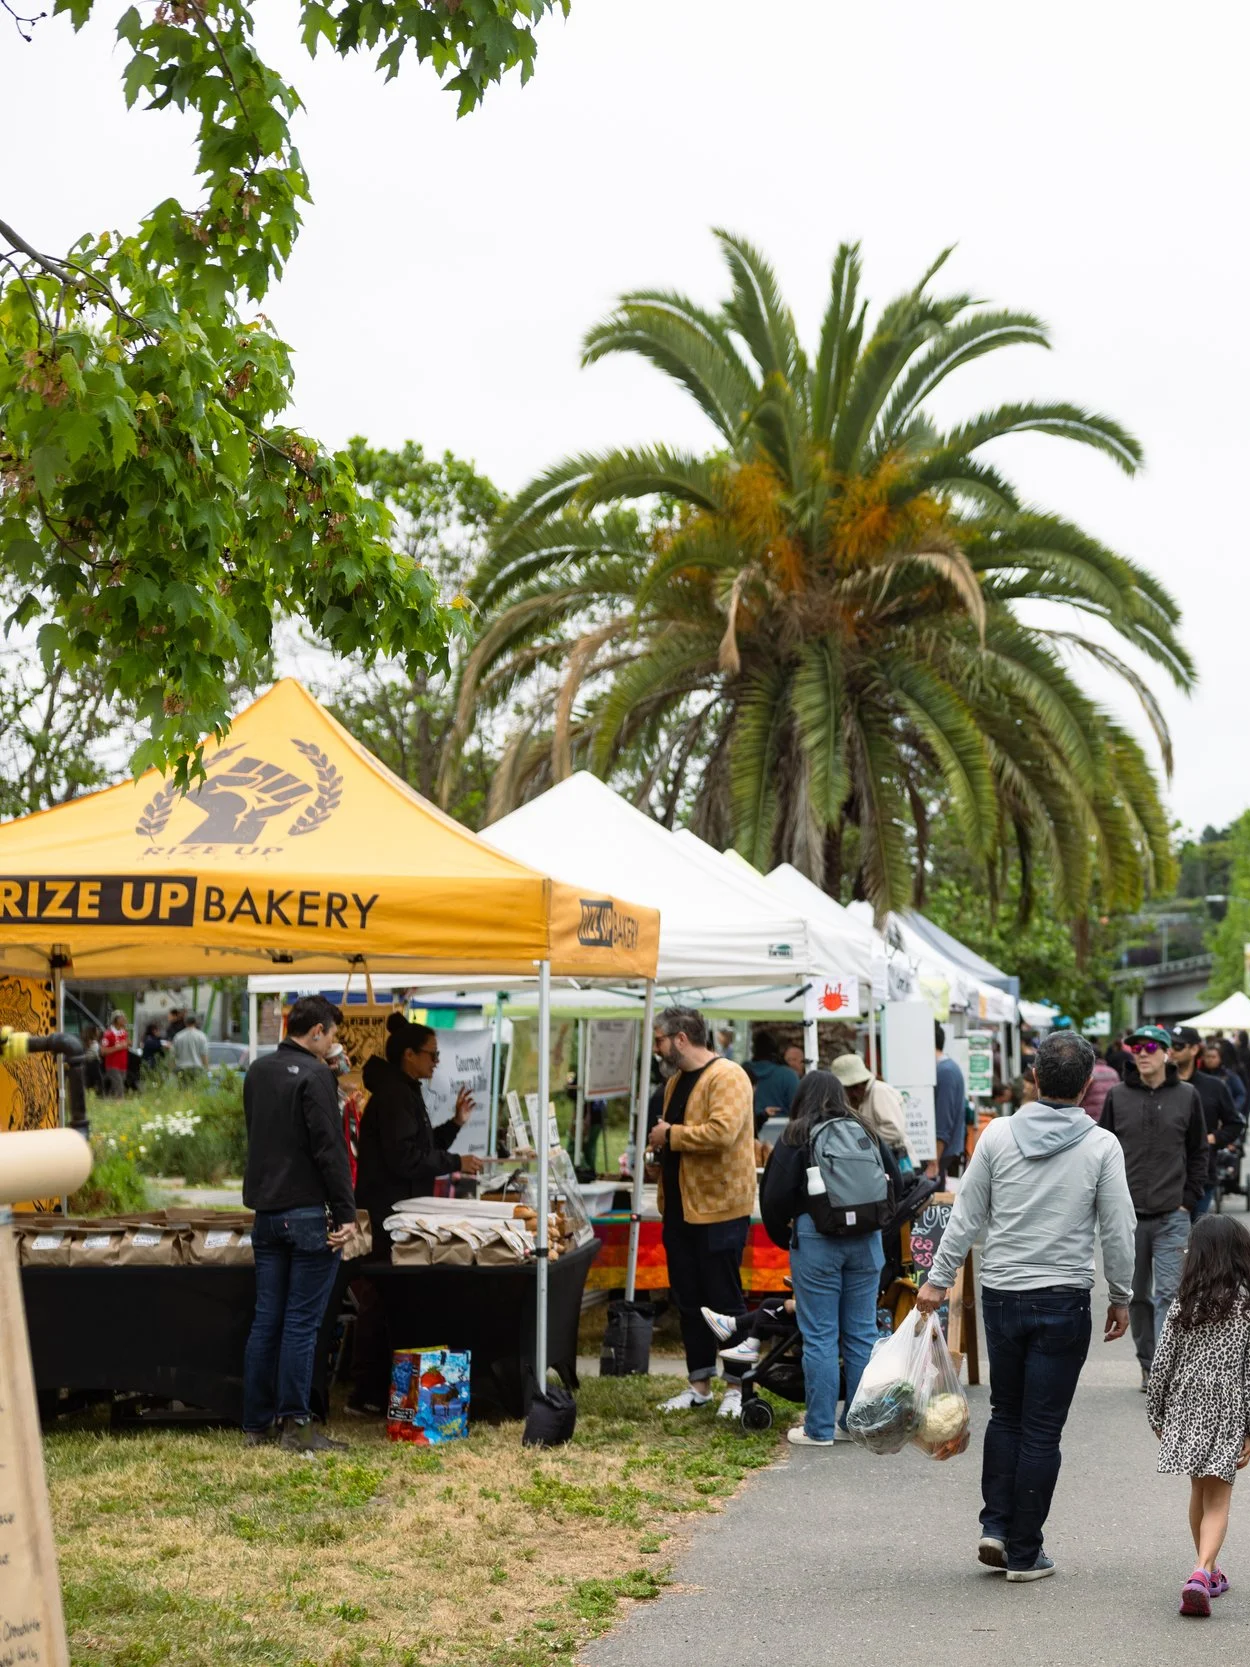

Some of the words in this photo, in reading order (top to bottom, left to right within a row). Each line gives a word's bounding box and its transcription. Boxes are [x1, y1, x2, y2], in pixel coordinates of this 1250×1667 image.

[234, 846, 284, 856] UP
[0, 880, 102, 919] RIZE
[120, 881, 190, 920] UP
[203, 885, 380, 930] BAKERY
[578, 905, 600, 940] RIZE
[600, 907, 612, 941] UP
[612, 910, 639, 951] BAKERY
[909, 1120, 928, 1128] BEST
